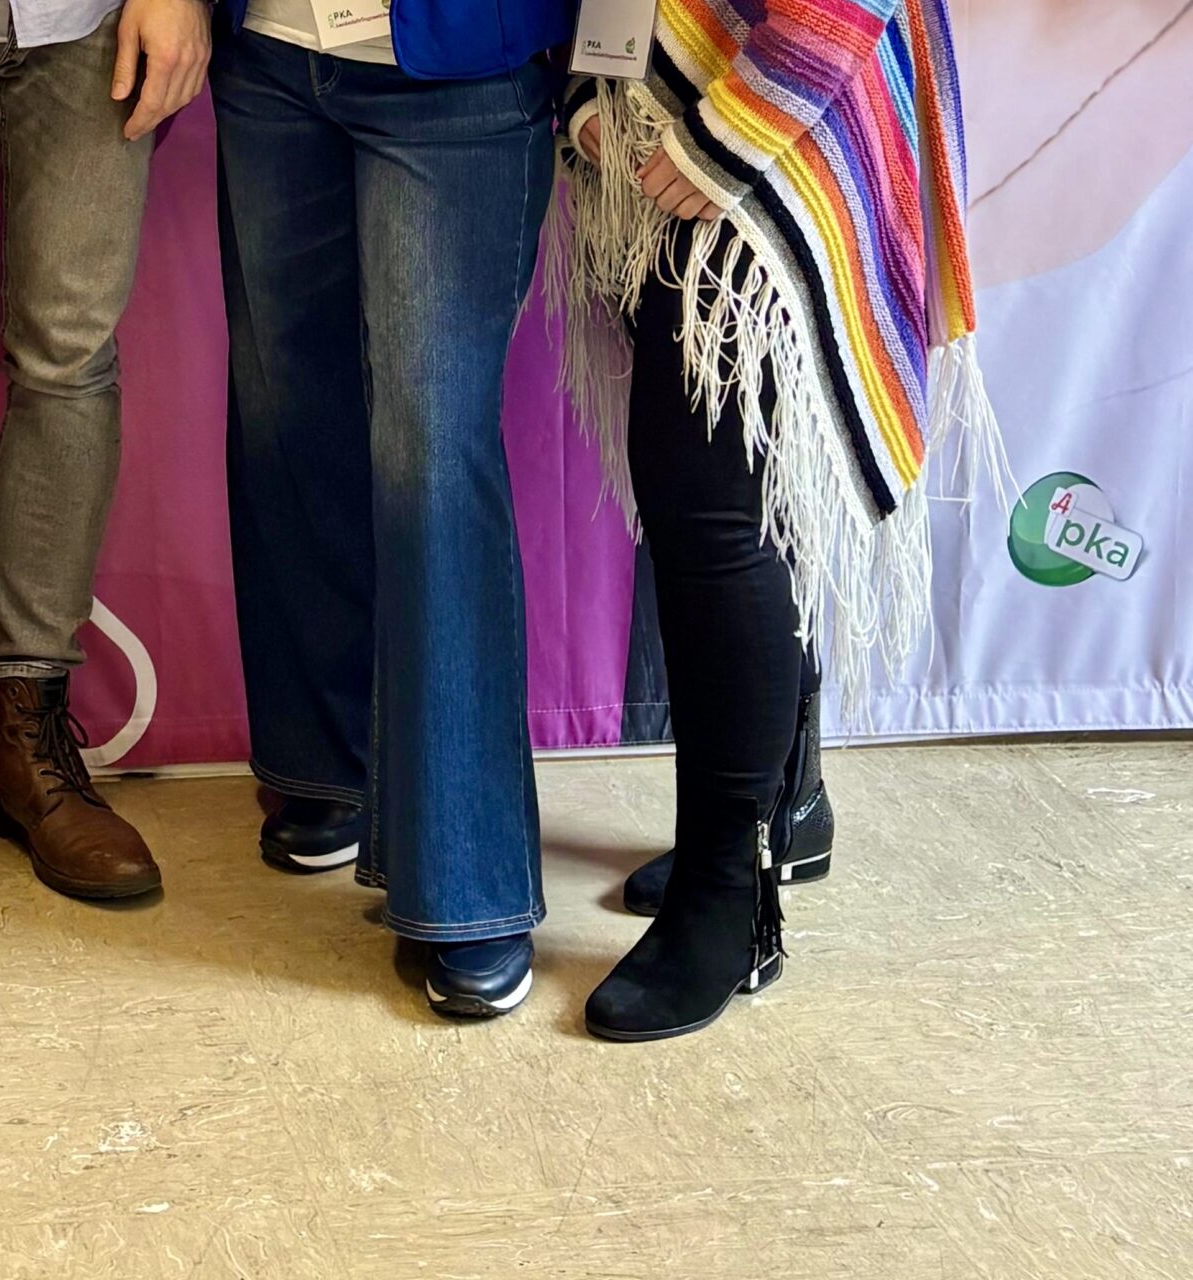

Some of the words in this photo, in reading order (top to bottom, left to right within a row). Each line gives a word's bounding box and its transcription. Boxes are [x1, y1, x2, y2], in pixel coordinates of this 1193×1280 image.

[333, 9, 353, 21] PKA
[586, 39, 602, 49] PKA
[1055, 519, 1131, 569] pka
